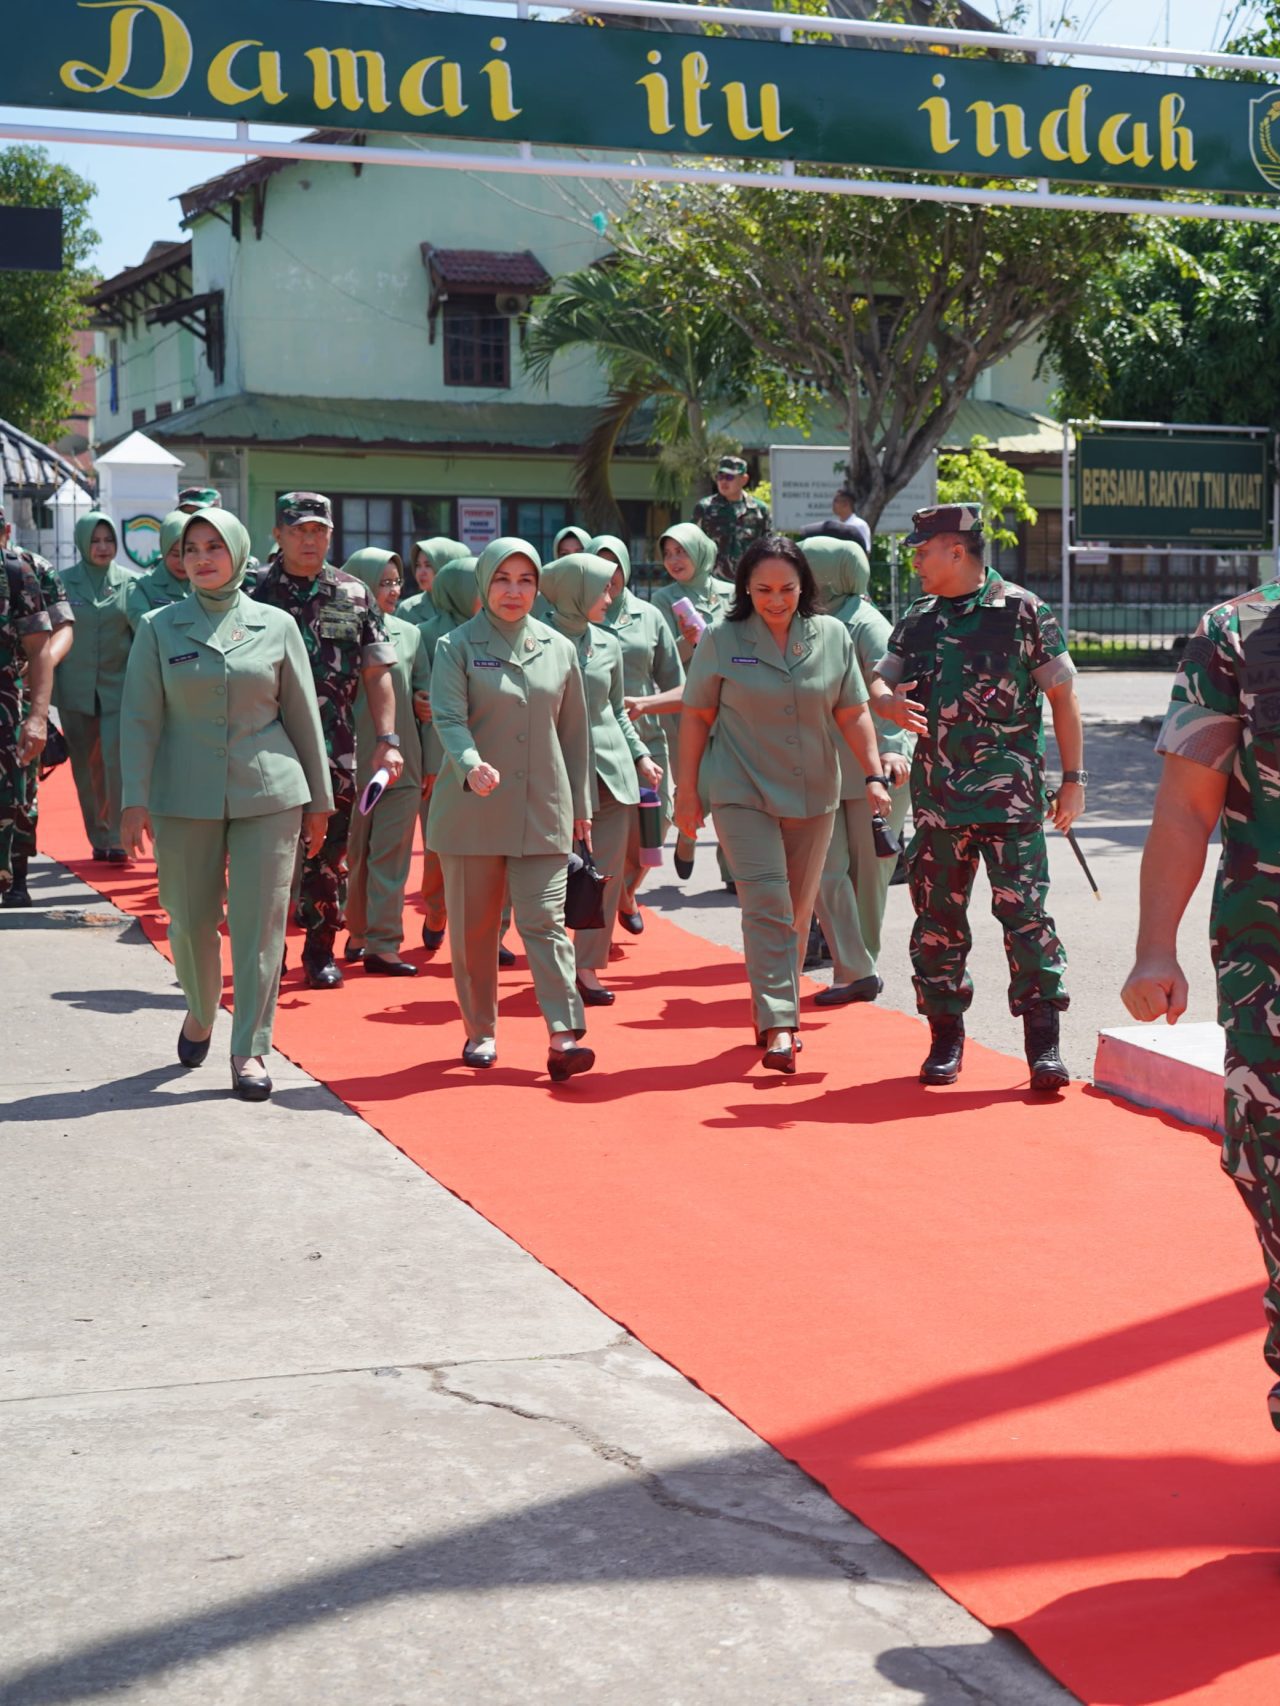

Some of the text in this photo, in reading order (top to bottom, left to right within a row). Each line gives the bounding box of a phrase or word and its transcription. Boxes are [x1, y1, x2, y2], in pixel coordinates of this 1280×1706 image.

[60, 0, 1198, 171] Damai itu indah
[1082, 468, 1263, 510] BERSAMA RAKYAT TNI KUAT
